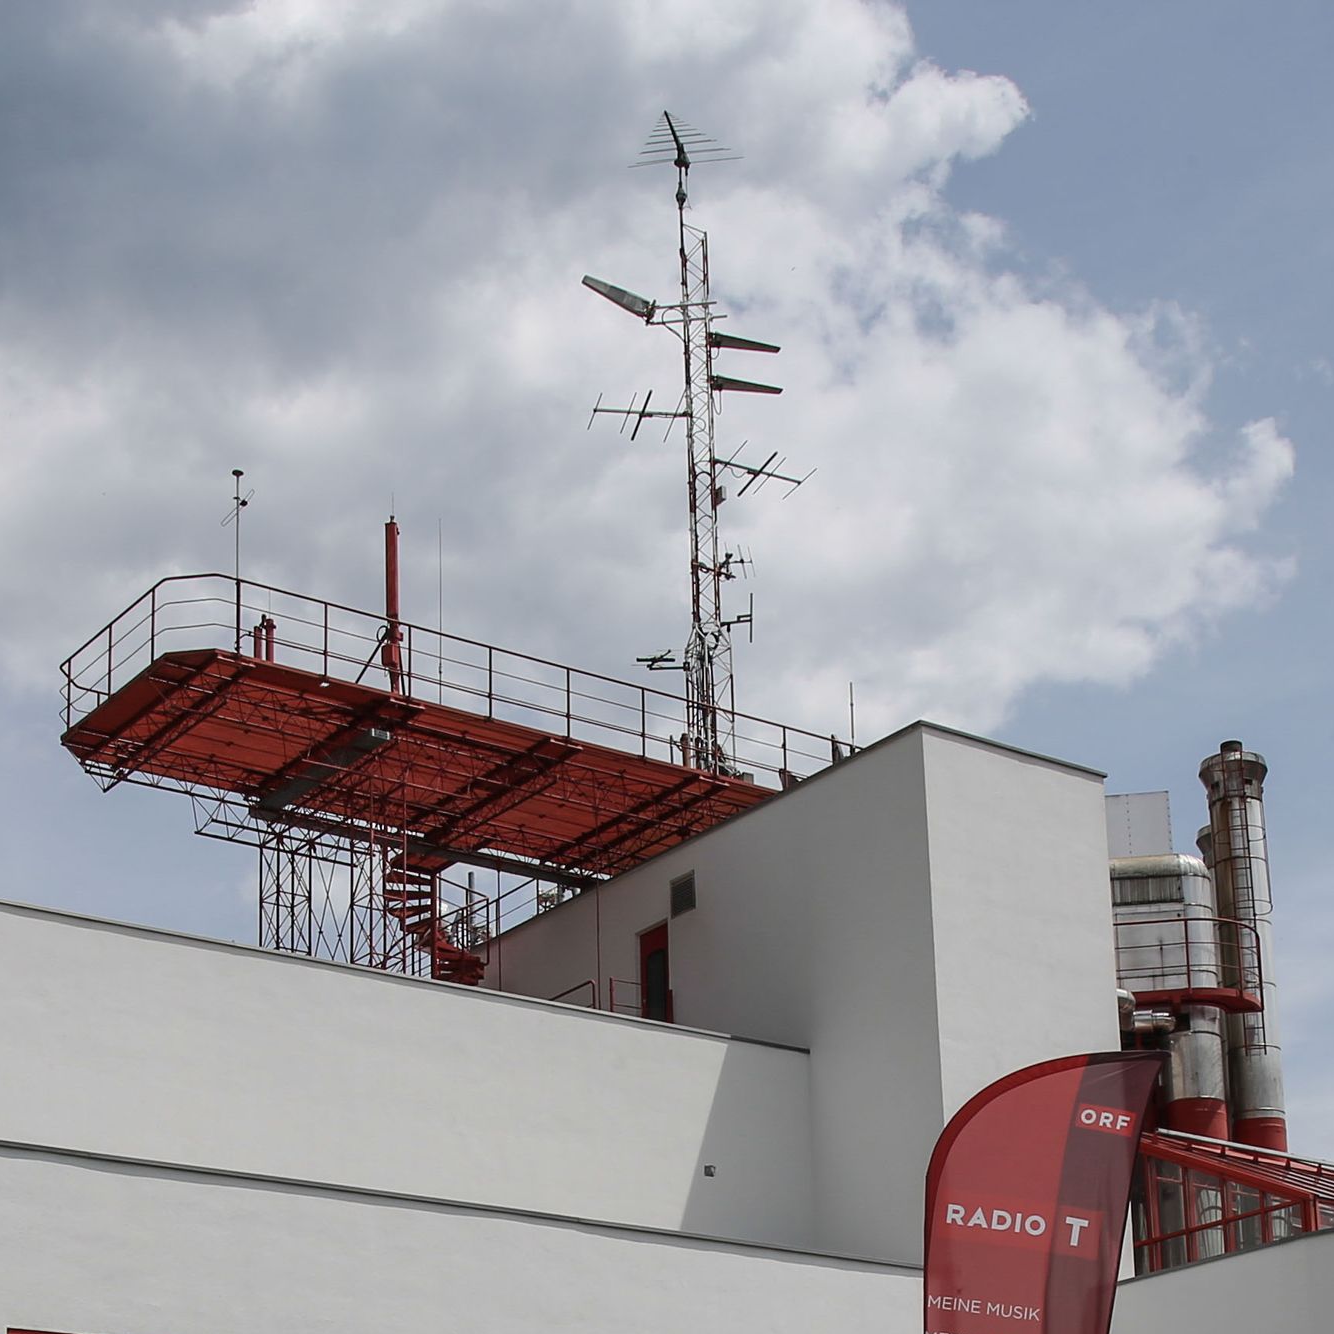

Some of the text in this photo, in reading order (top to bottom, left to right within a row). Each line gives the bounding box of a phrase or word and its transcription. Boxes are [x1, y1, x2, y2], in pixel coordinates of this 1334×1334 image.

[1080, 1108, 1131, 1130] ORF
[945, 1203, 1090, 1247] RADIO T
[927, 1294, 1040, 1321] MEINE MUSIK
